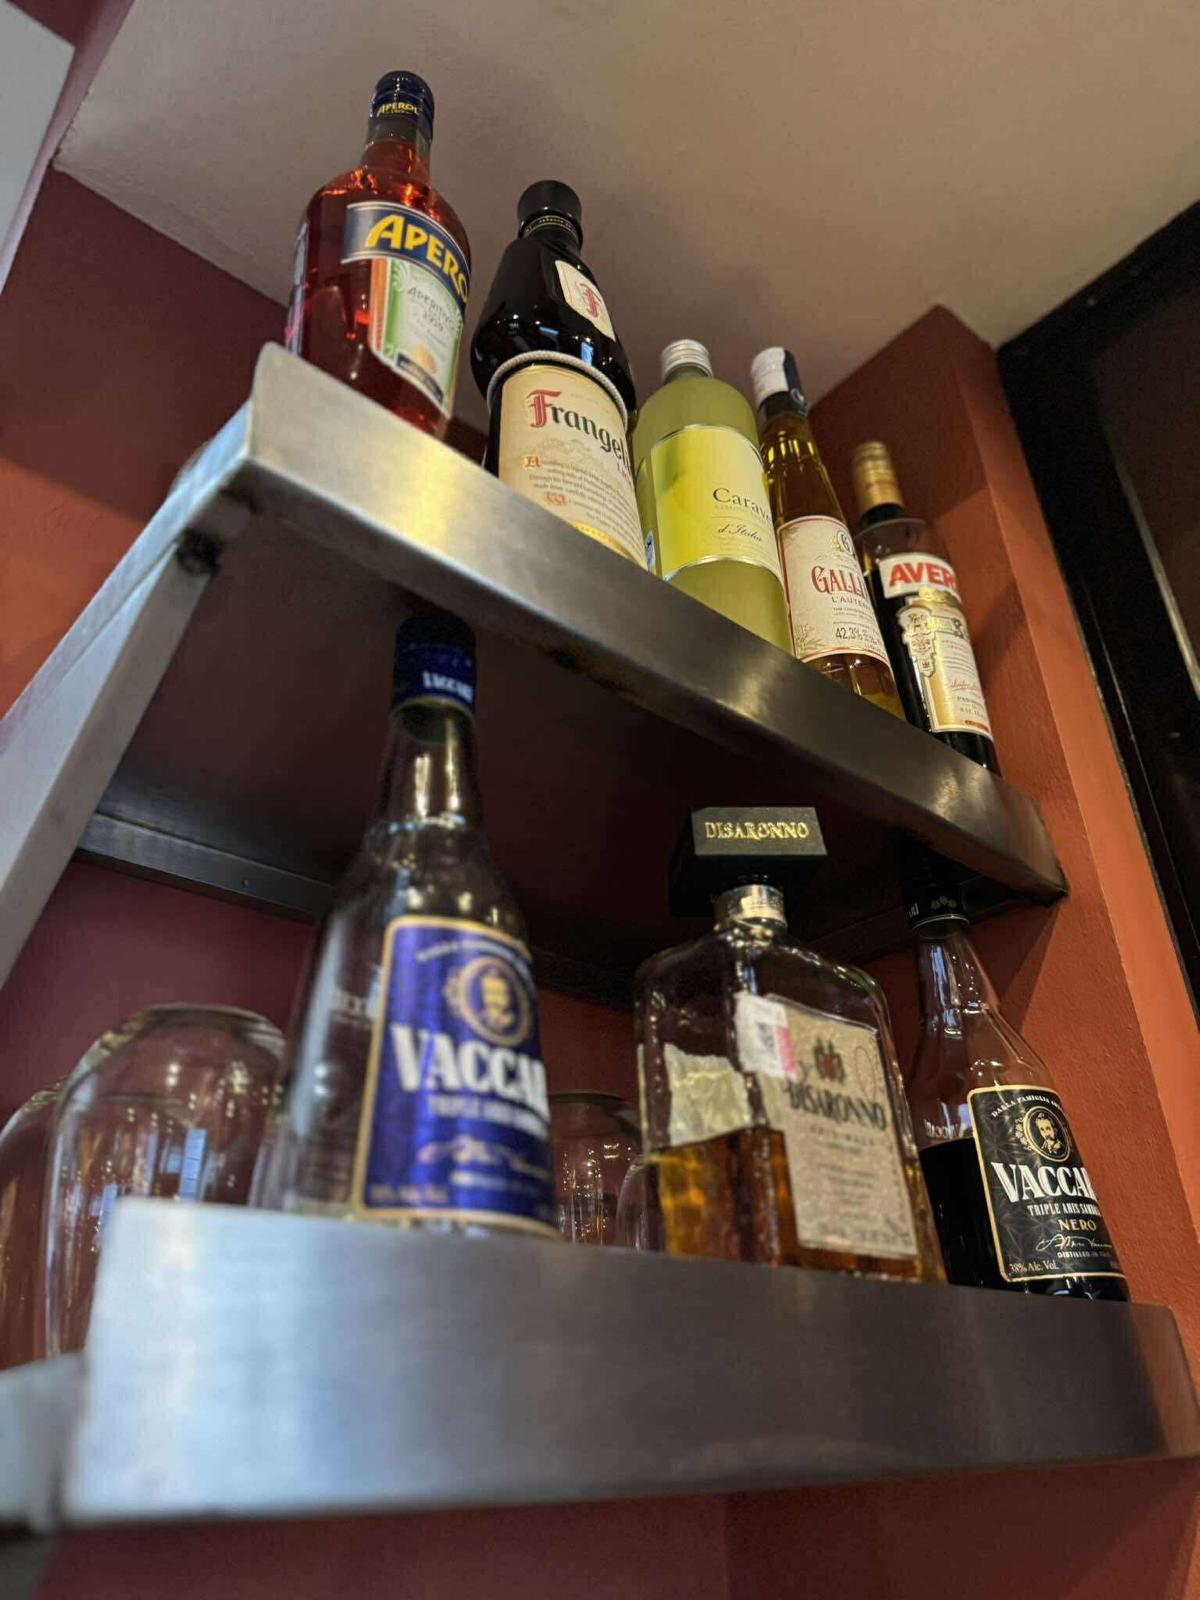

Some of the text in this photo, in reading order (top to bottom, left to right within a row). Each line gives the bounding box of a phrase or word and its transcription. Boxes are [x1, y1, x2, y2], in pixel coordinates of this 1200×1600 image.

[377, 102, 420, 117] APEROL
[704, 822, 809, 840] DISARONNO
[1027, 1202, 1061, 1217] TRIPLE
[1058, 1219, 1097, 1232] NERO
